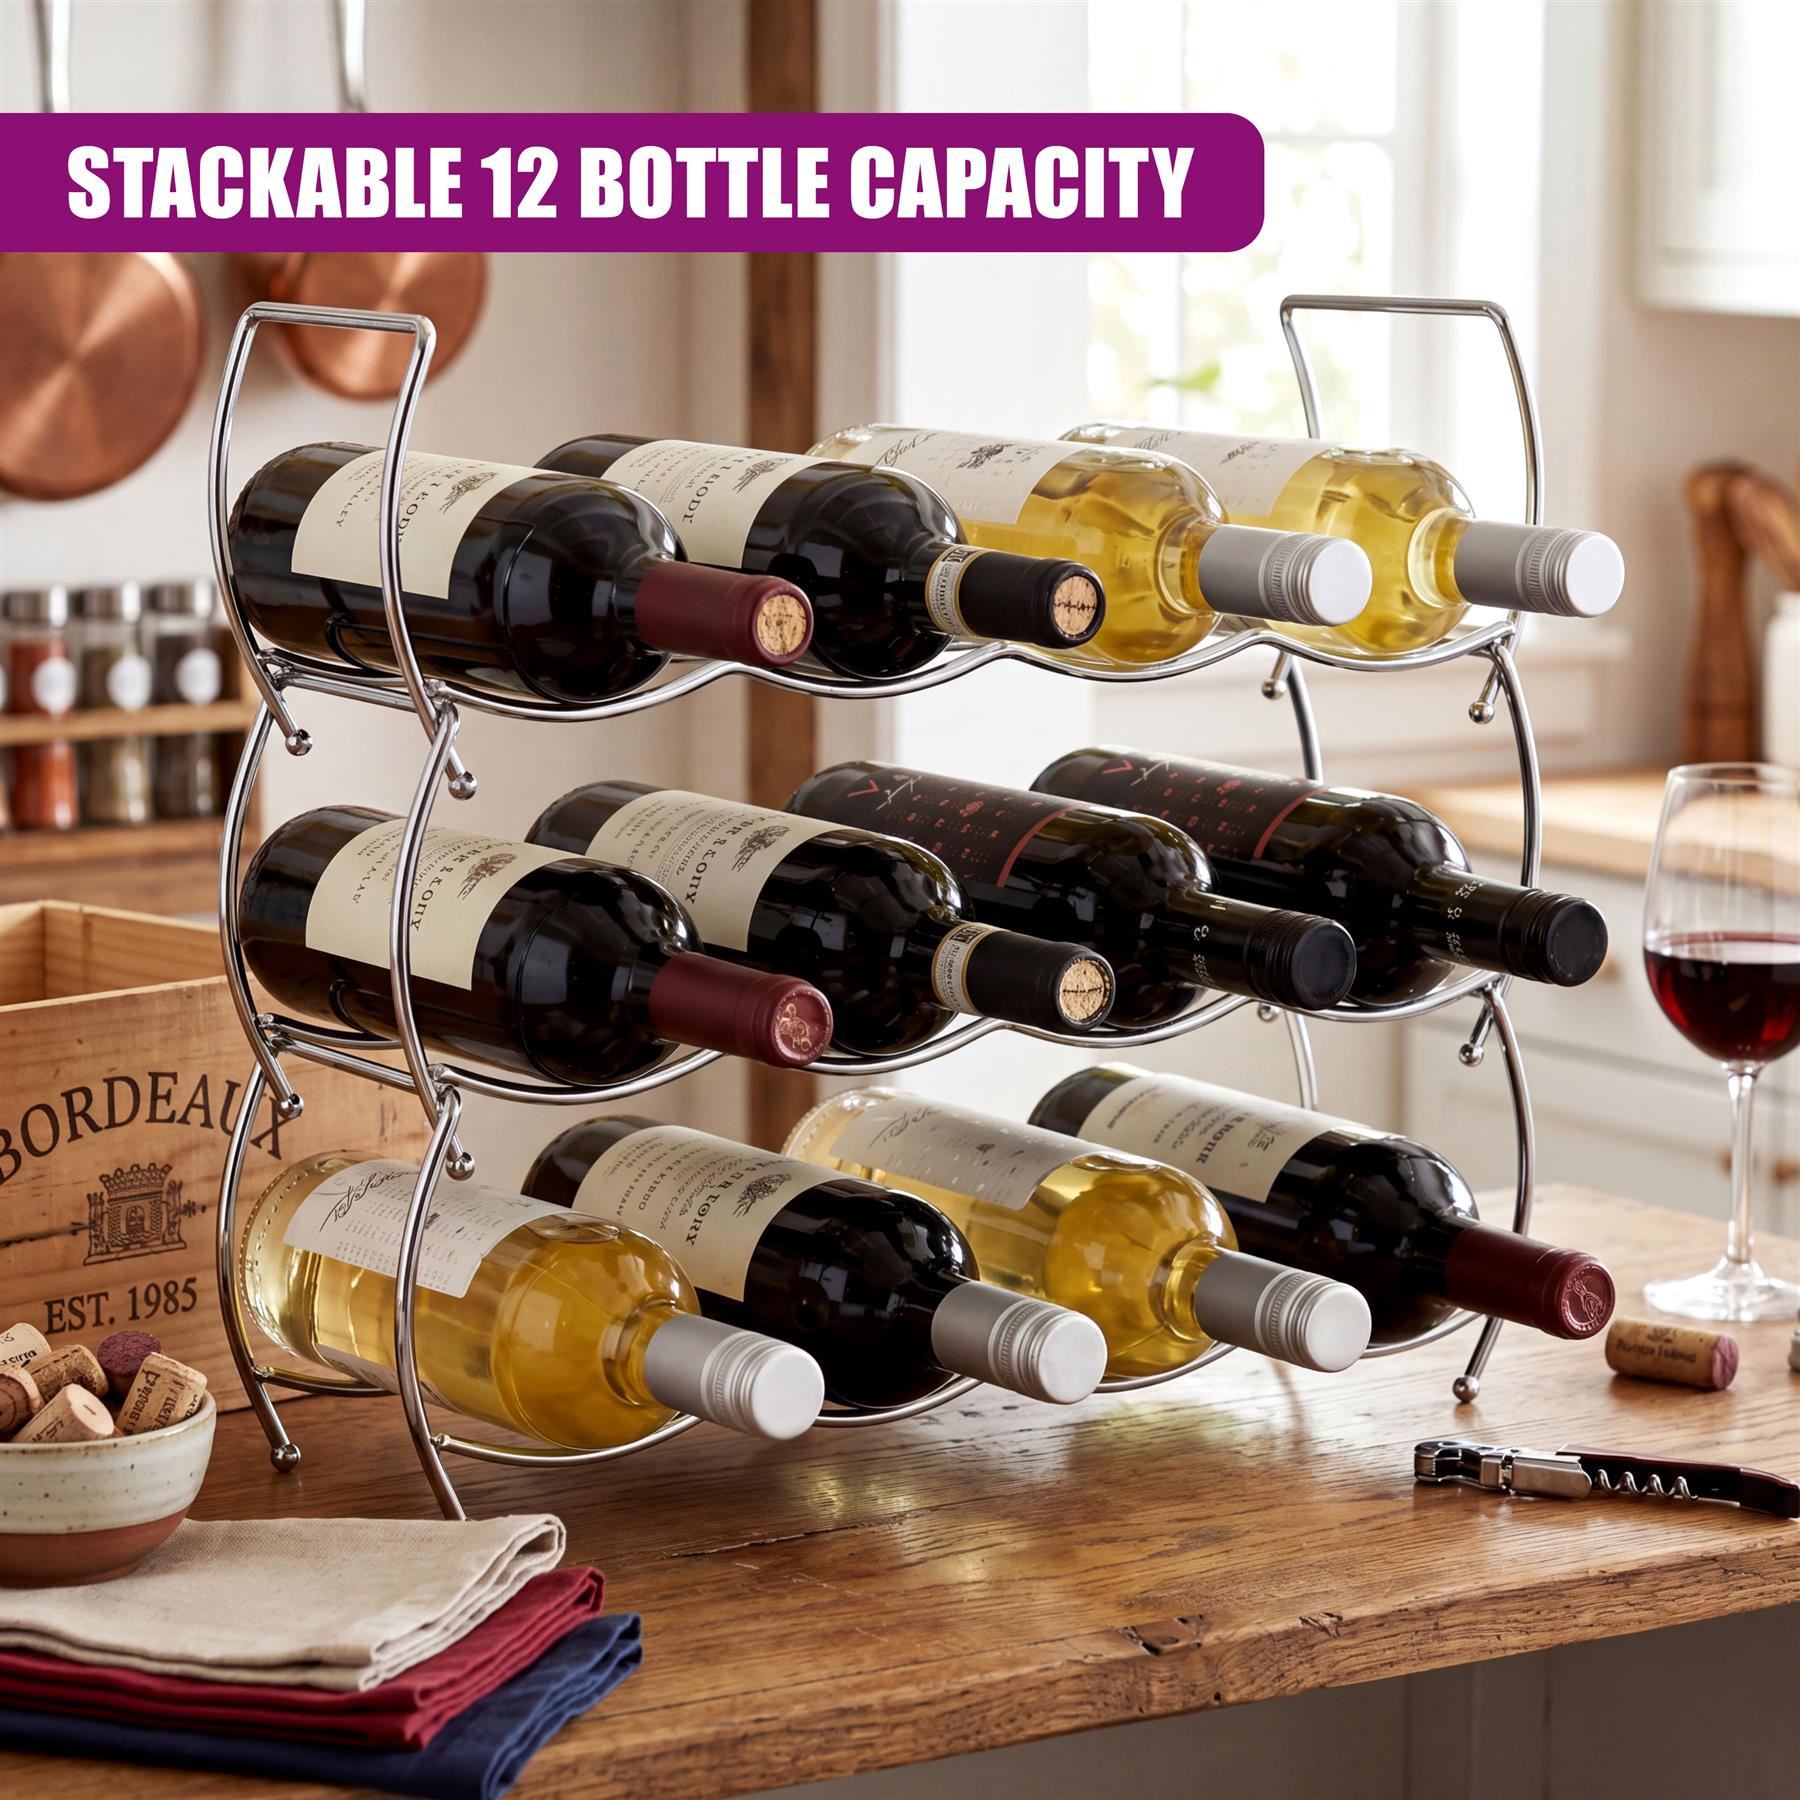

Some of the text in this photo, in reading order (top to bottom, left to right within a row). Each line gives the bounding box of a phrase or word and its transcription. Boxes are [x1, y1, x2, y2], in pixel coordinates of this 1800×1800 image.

[0, 1071, 302, 1186] BORDEAUX
[44, 1277, 197, 1336] EST. 1985
